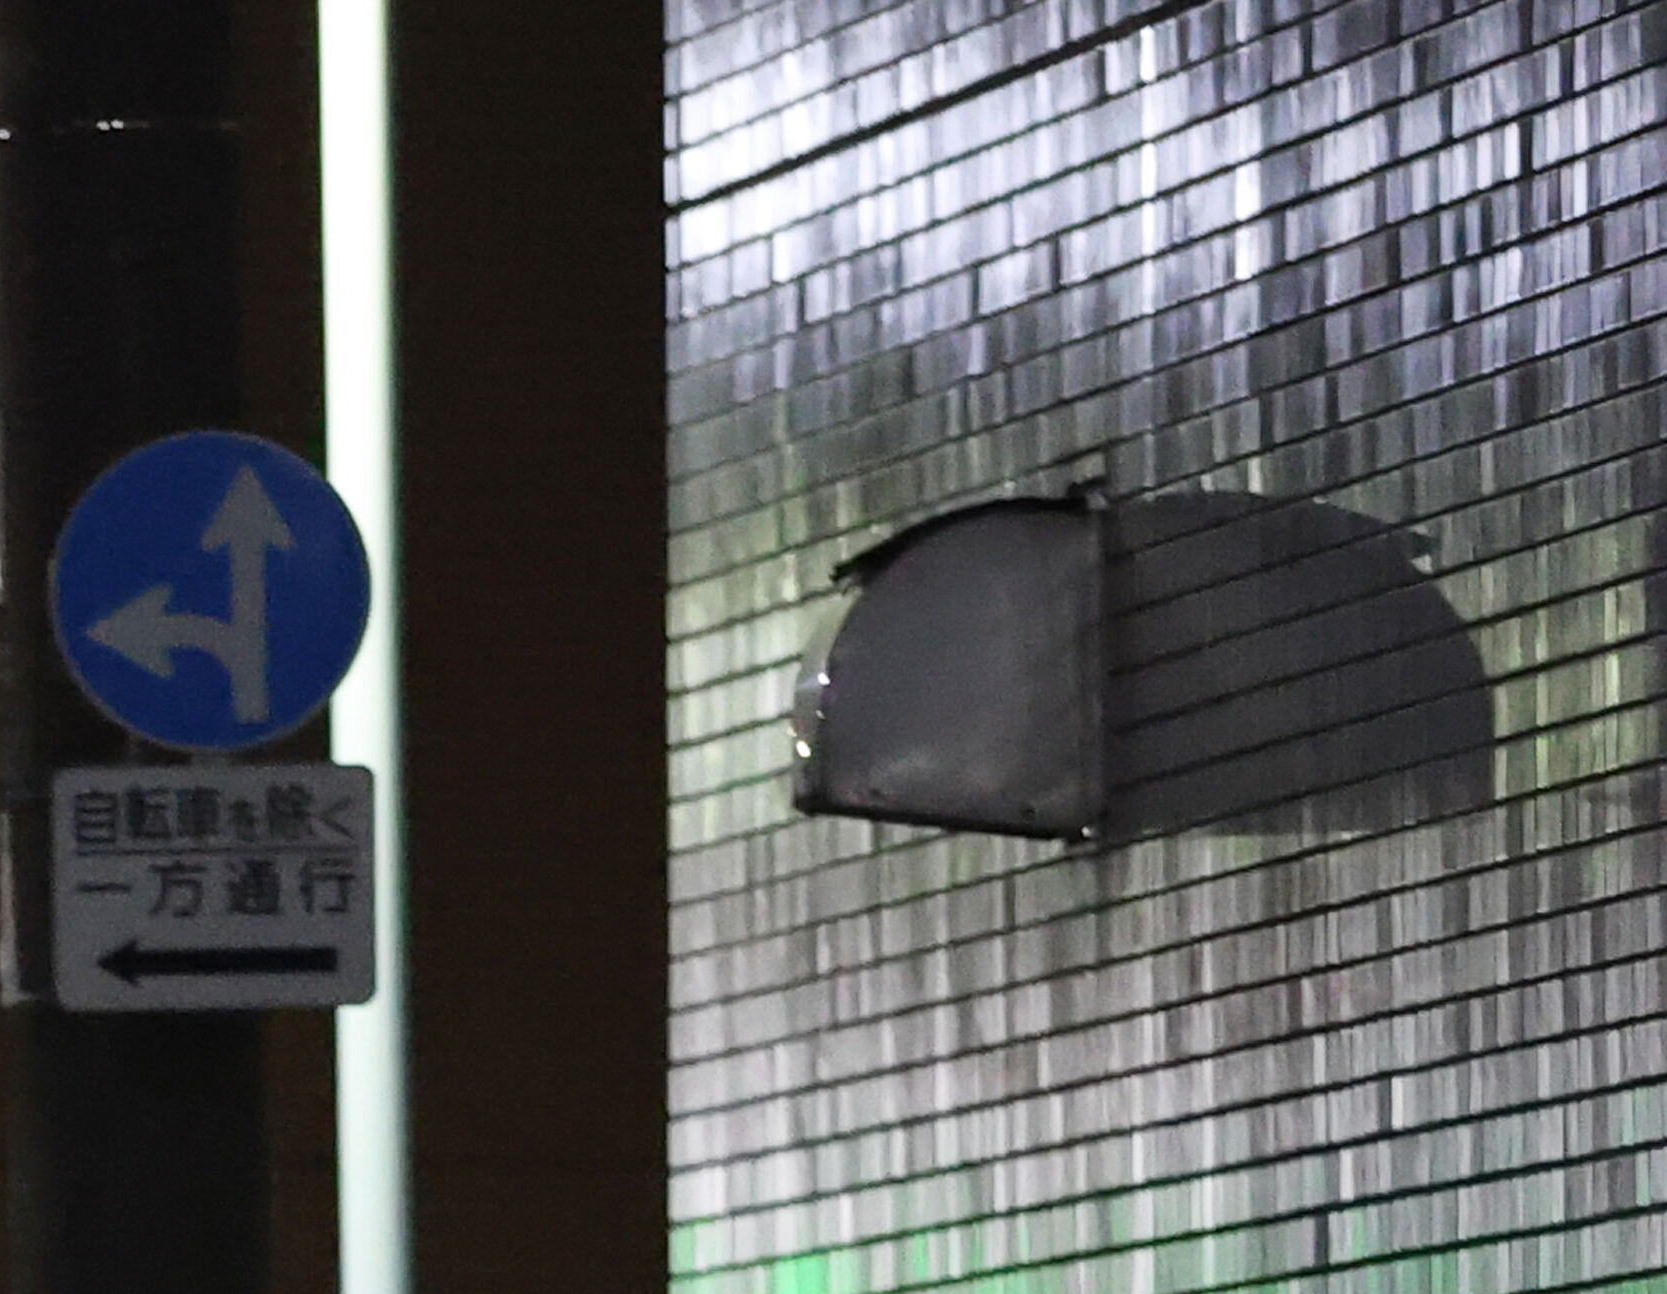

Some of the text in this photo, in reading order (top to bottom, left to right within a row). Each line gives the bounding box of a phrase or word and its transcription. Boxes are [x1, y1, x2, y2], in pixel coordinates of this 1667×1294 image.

[74, 783, 356, 844] 自転車を除く
[75, 856, 356, 917] 一方通行
